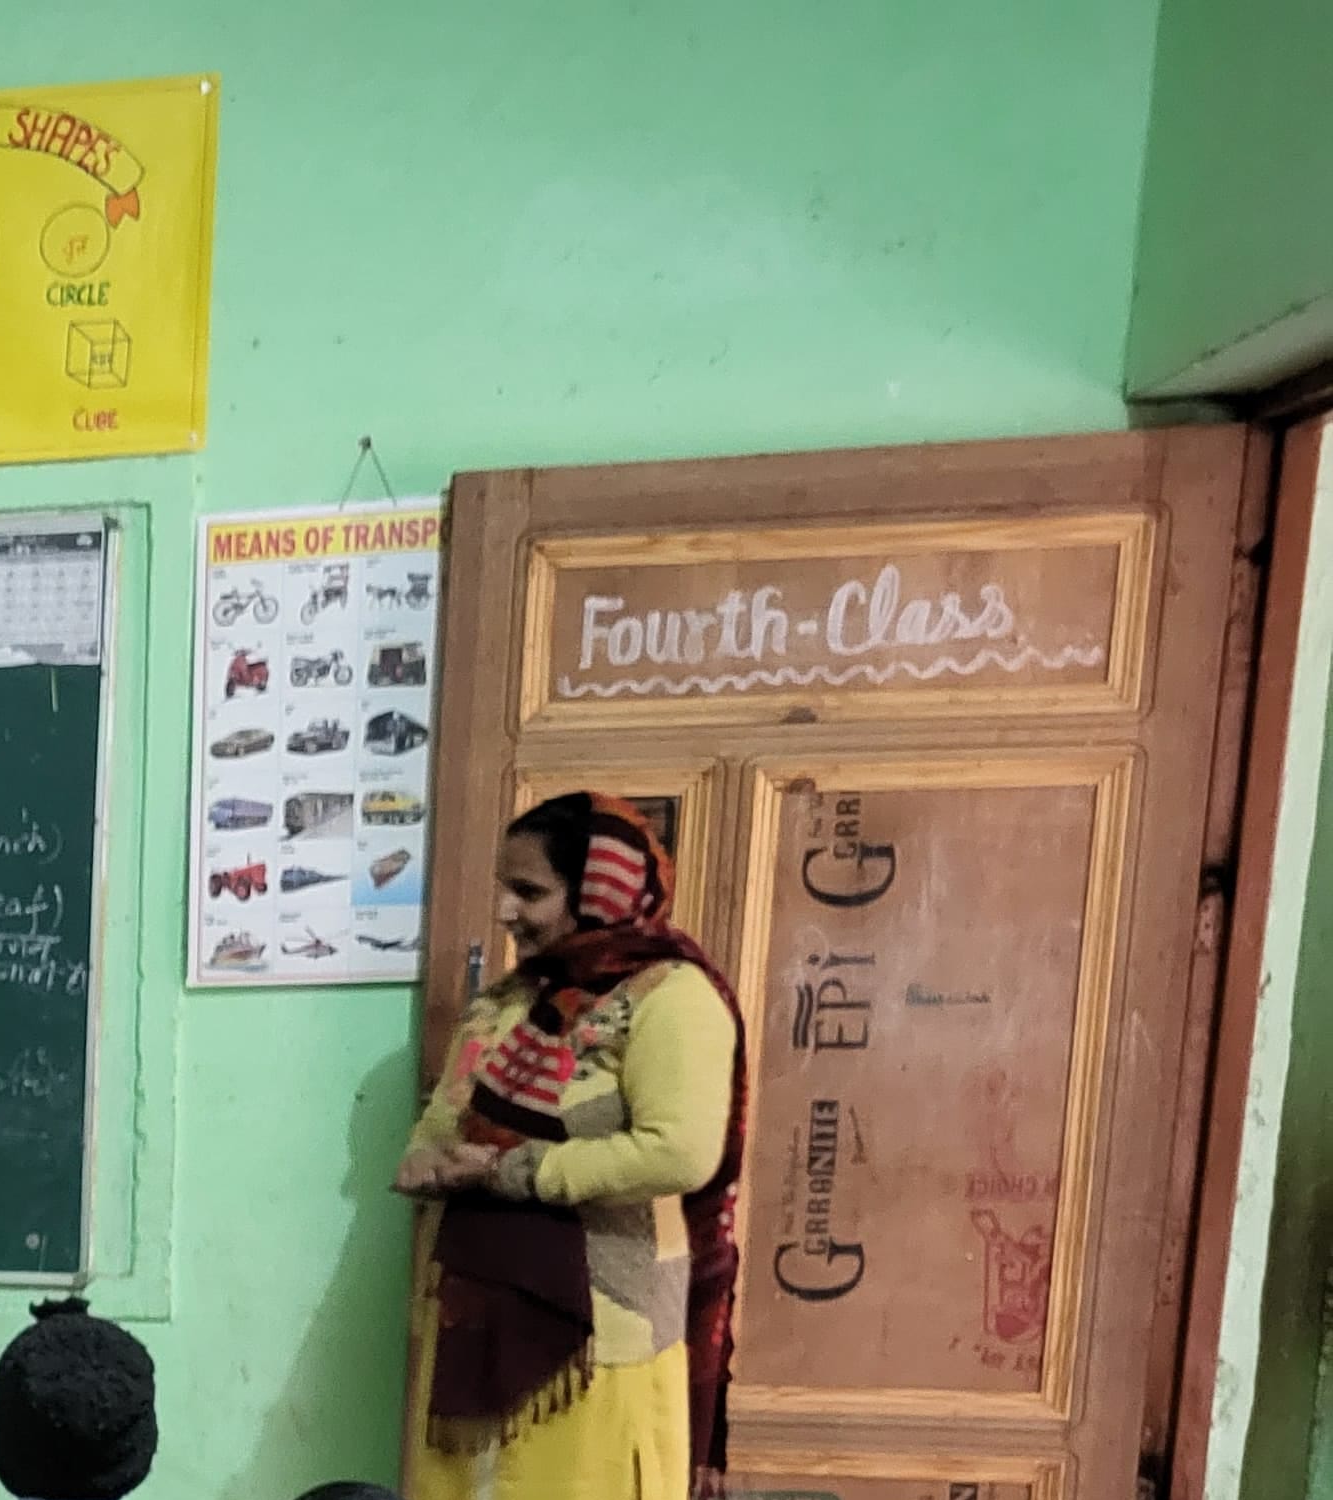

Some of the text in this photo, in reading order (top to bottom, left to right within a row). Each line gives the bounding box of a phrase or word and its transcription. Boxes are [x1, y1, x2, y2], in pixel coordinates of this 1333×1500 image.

[9, 106, 123, 179] SHAPES
[46, 281, 111, 307] CIRCLE
[73, 408, 119, 432] CUBE
[213, 517, 439, 562] MEANS OF TRANSP
